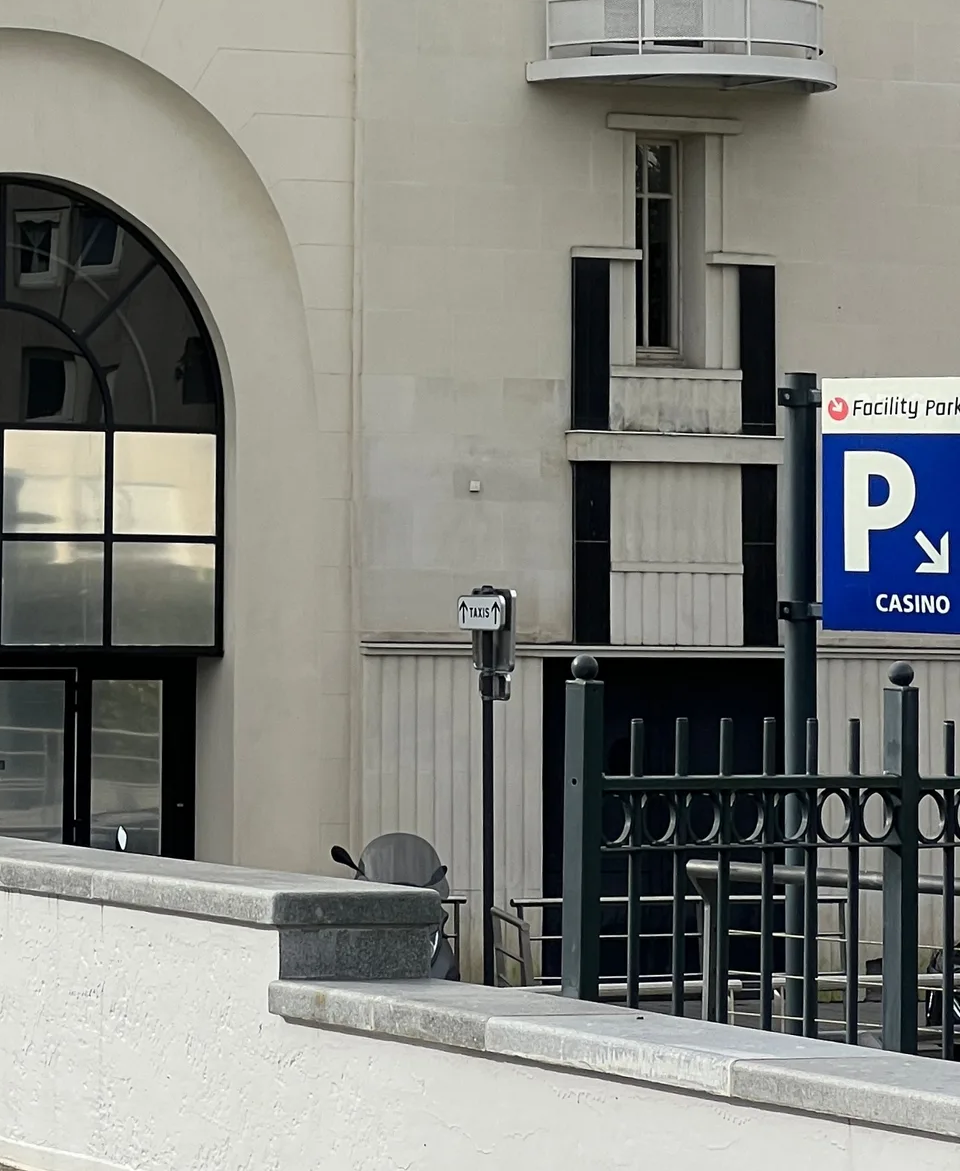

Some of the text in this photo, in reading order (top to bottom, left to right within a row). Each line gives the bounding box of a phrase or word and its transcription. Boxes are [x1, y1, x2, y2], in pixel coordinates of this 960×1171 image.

[852, 396, 919, 420] Facility
[844, 450, 916, 572] P
[469, 607, 490, 619] TAXIS
[875, 593, 951, 615] CASINO
